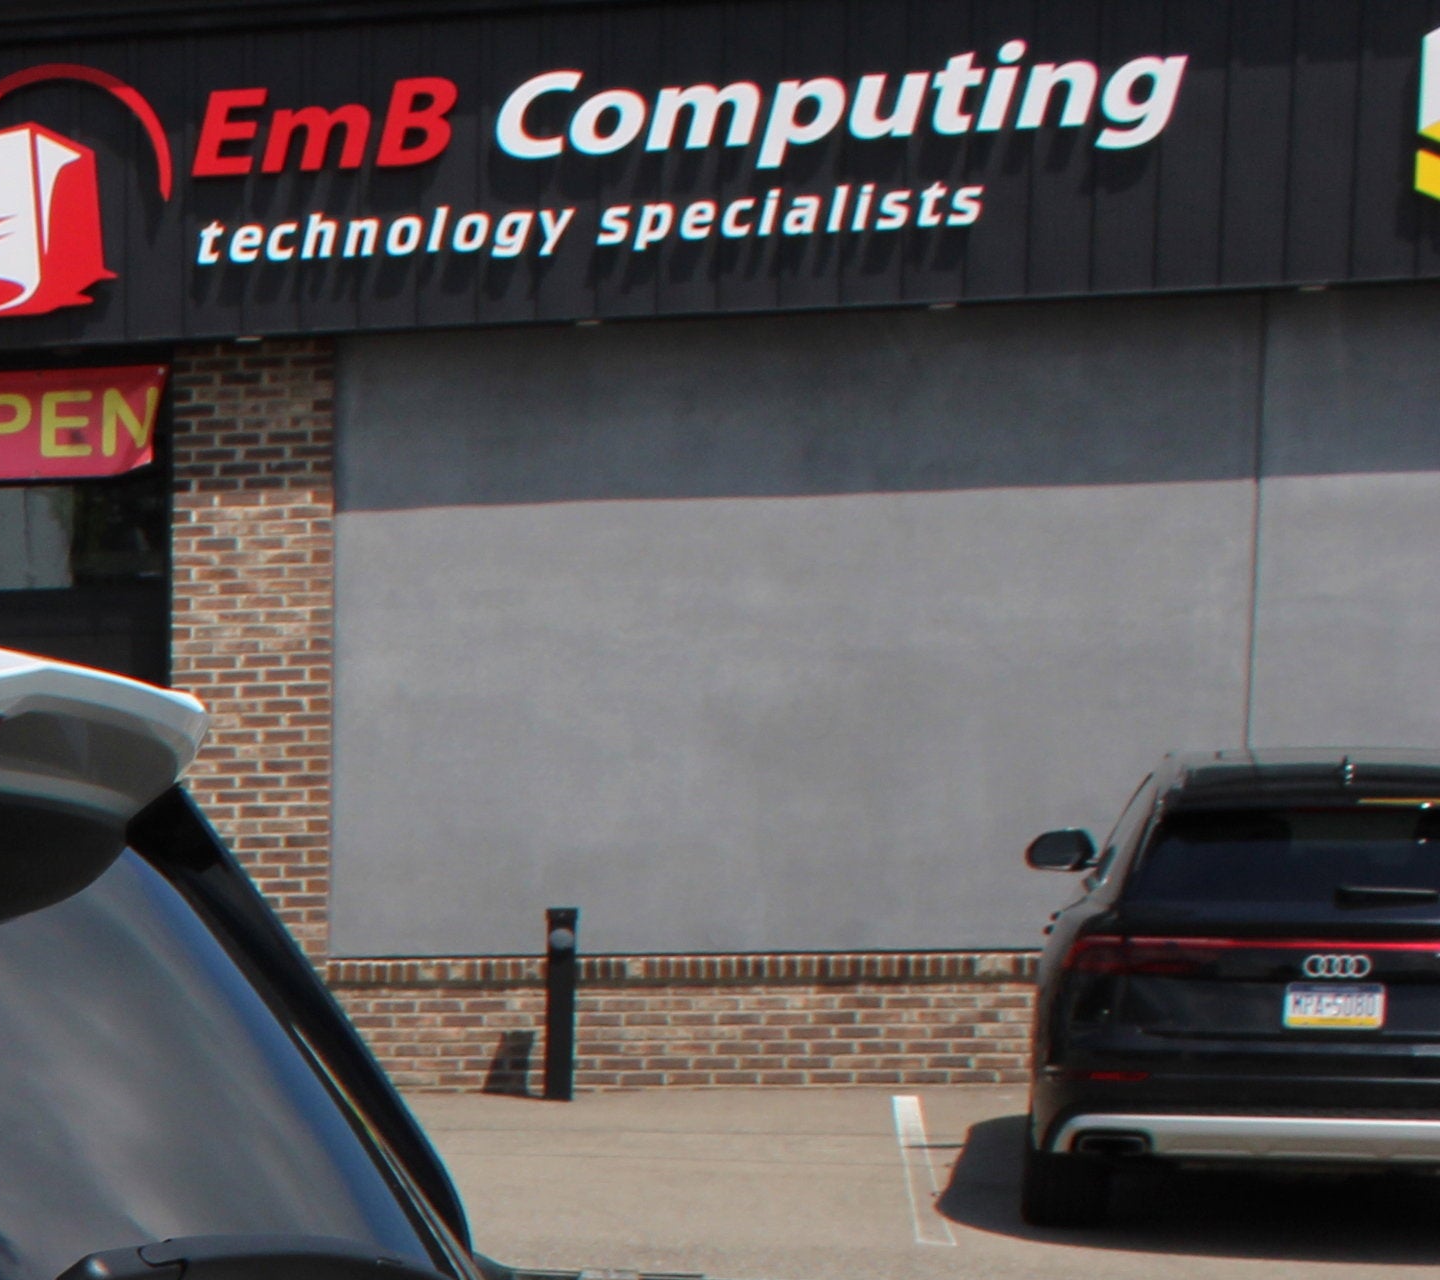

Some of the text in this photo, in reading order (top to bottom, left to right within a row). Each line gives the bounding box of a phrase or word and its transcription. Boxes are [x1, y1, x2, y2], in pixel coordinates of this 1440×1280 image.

[191, 39, 1189, 178] EmB Computing
[196, 181, 984, 266] technology specialists
